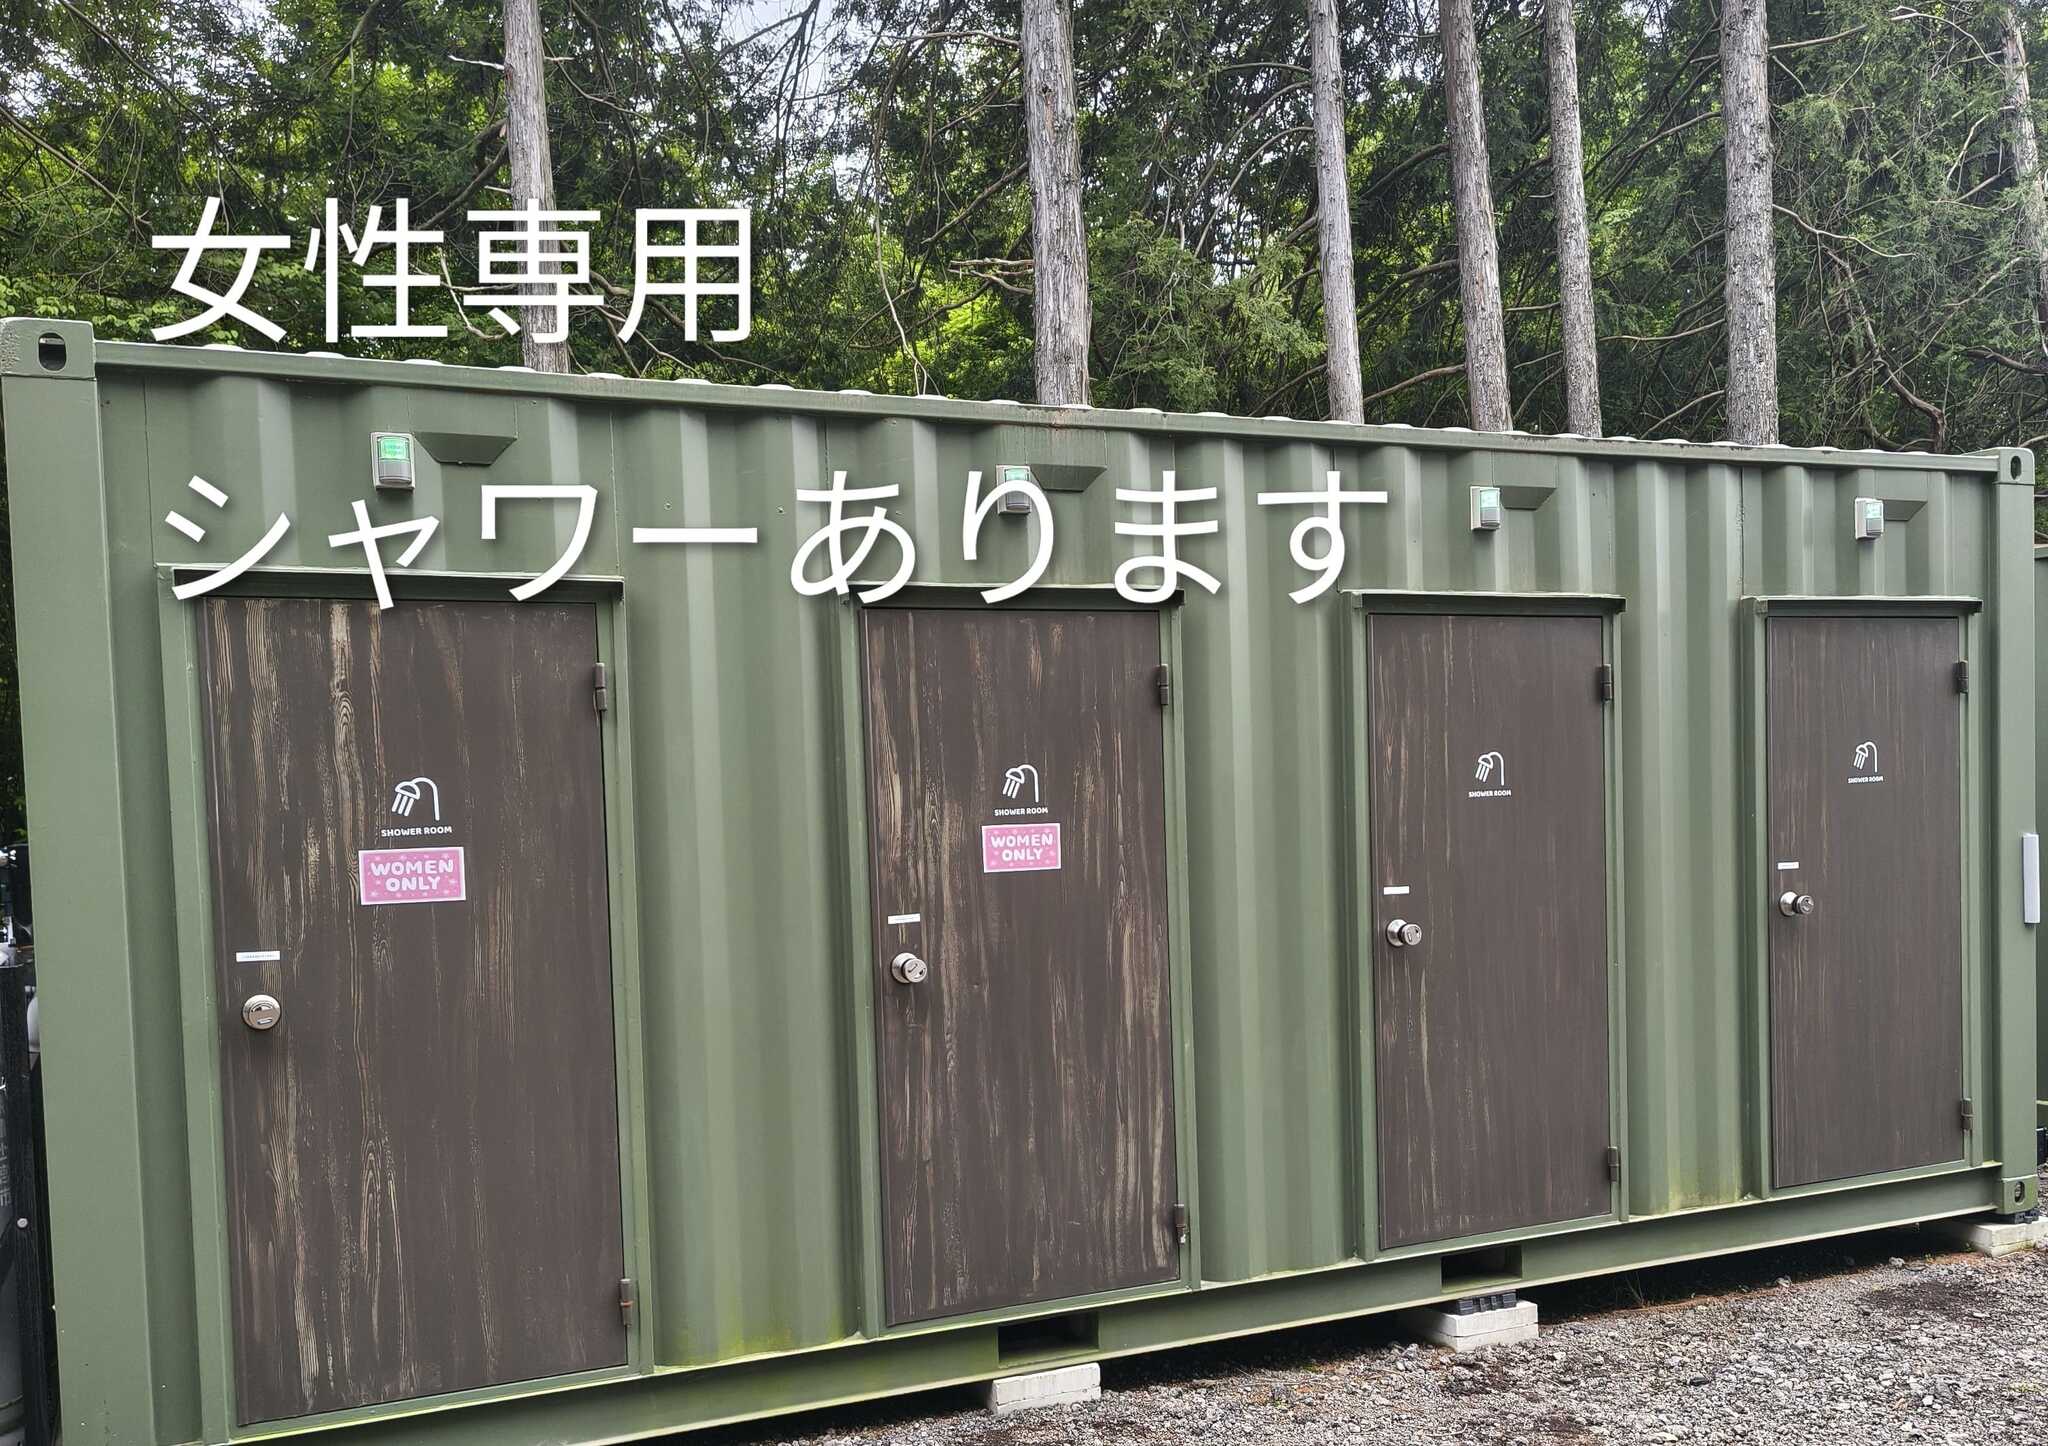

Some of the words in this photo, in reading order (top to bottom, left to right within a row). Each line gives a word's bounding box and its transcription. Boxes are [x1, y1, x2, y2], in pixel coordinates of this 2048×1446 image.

[994, 808, 1025, 817] SHOWER
[1026, 807, 1049, 815] ROOM
[381, 827, 422, 837] SHOWER
[424, 826, 453, 834] ROOM
[990, 833, 1054, 848] WOMEN
[1002, 848, 1043, 862] ONLY
[370, 859, 454, 877] WOMEN
[385, 876, 441, 892] ONLY
